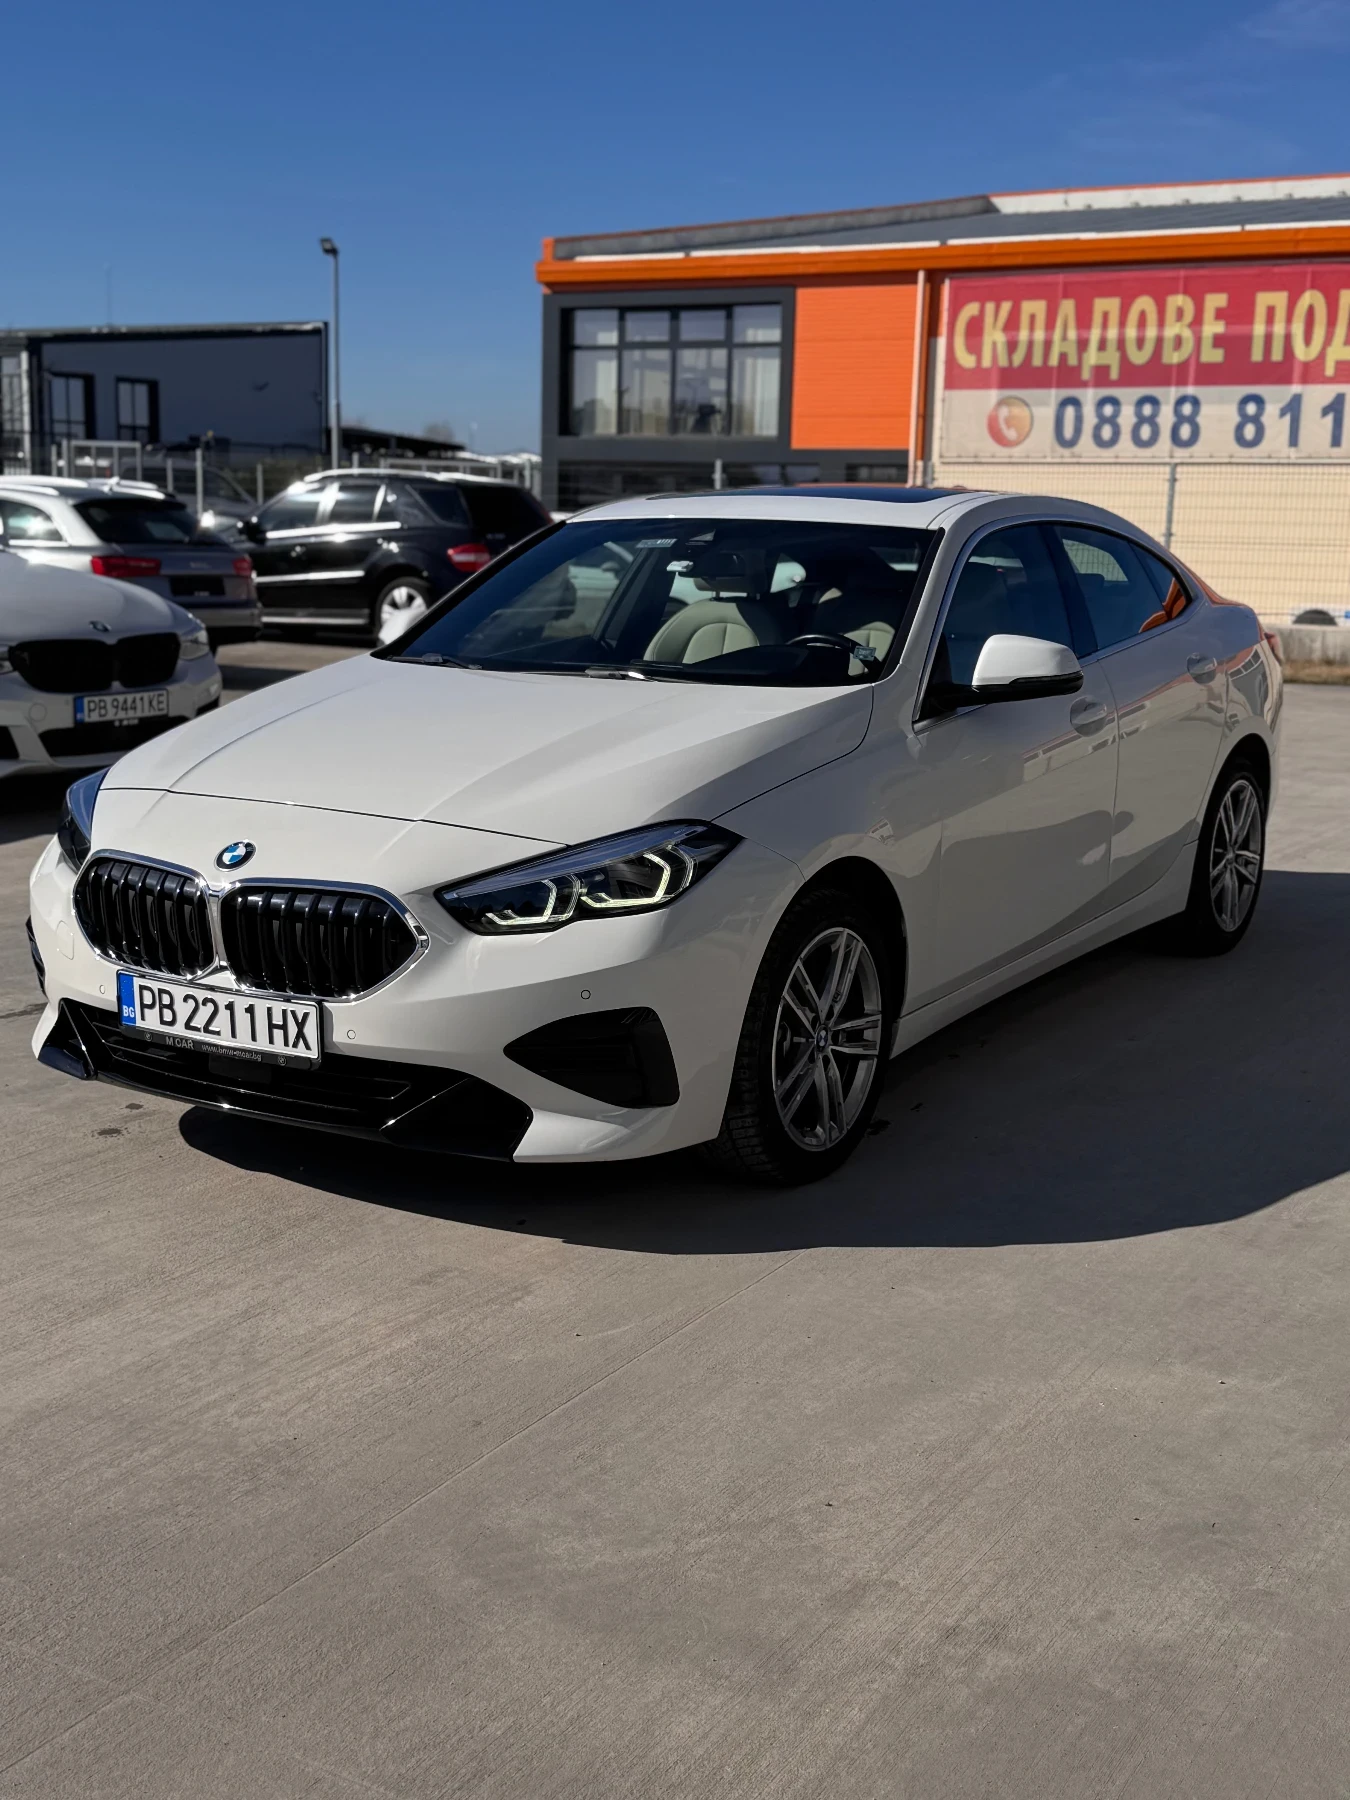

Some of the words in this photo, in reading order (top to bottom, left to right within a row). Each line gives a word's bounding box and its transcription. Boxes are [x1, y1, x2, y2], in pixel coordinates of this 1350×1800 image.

[953, 293, 1229, 381] СКЛАДОВЕ
[1054, 394, 1202, 449] 0888
[1234, 392, 1346, 449] 811
[87, 699, 108, 719] PB
[111, 696, 145, 717] 9441
[148, 693, 165, 713] KE
[123, 1005, 135, 1018] BG
[138, 984, 177, 1027] PB
[182, 993, 258, 1043] 2211
[266, 1005, 313, 1051] HX
